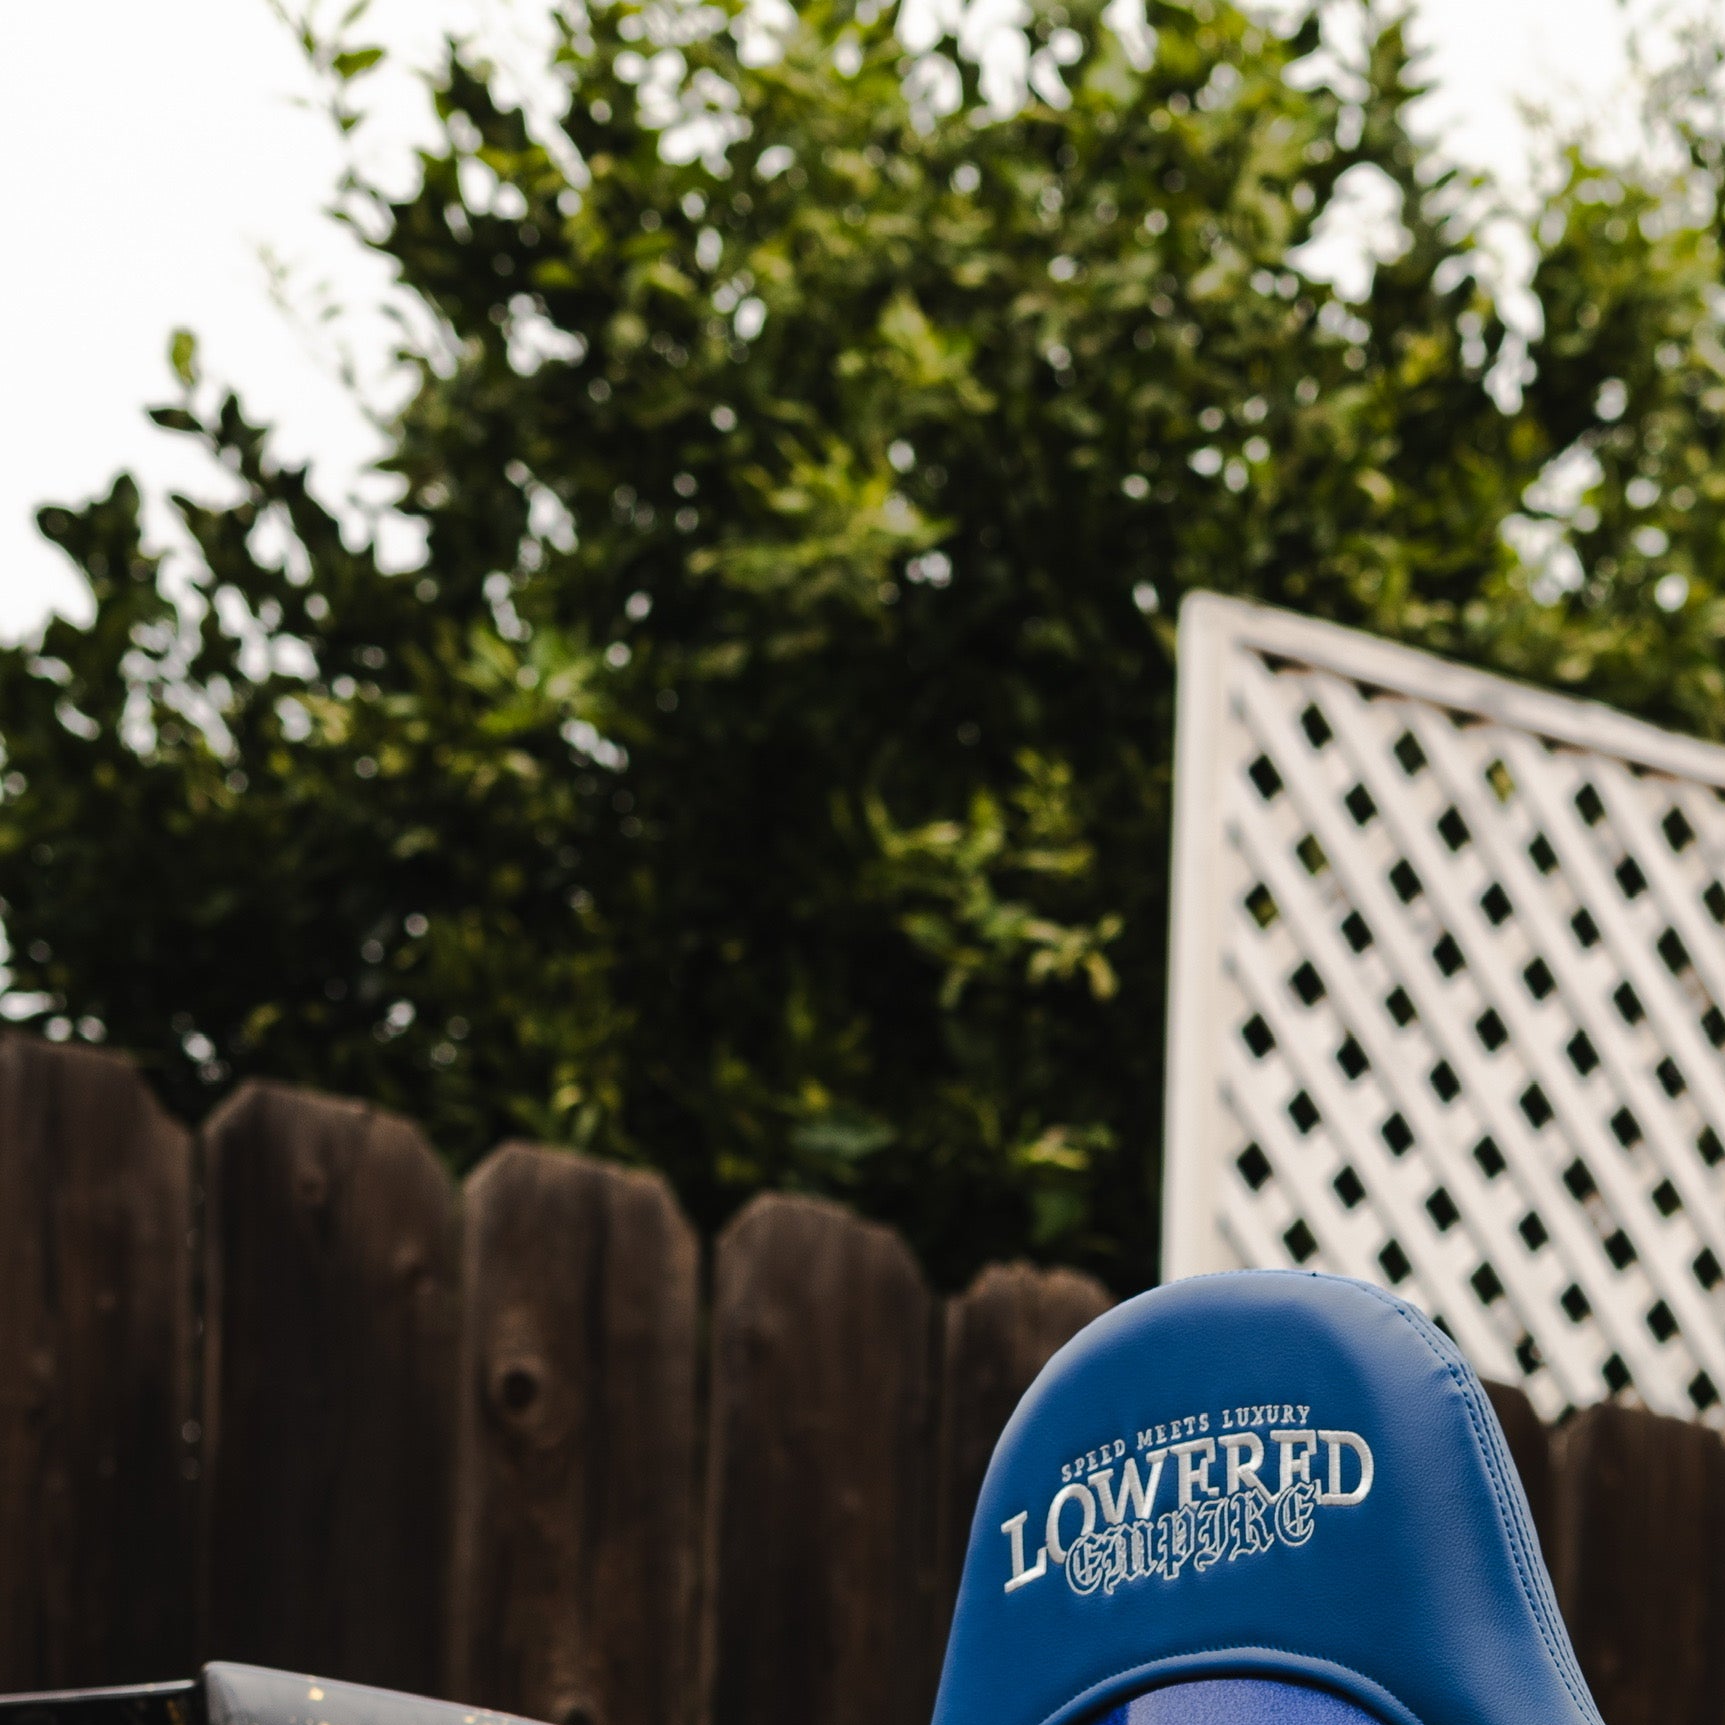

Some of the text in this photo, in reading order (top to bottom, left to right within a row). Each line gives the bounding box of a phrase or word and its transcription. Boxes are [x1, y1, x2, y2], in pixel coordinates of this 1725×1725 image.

[1061, 1404, 1310, 1482] SPEED MEETS LUXURY
[1001, 1429, 1375, 1594] LOWERED
